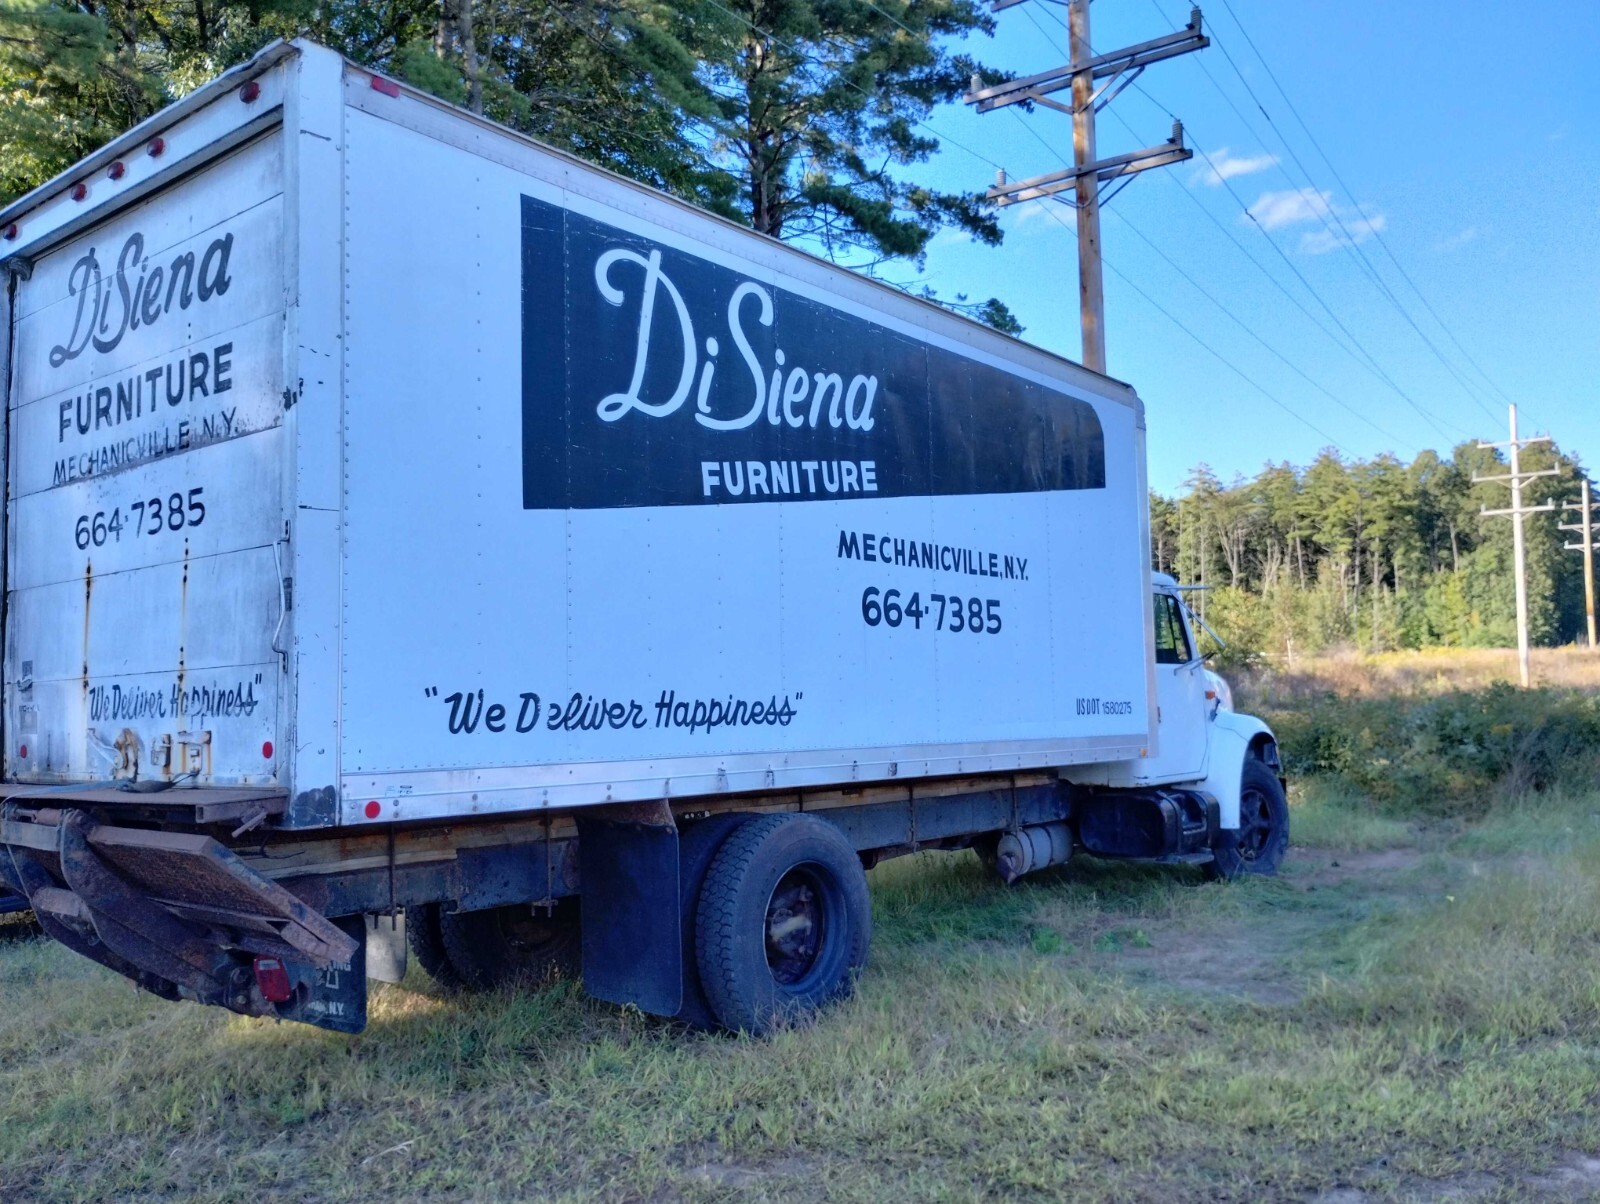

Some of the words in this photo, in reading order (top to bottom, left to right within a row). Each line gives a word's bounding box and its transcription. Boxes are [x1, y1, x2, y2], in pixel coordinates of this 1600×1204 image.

[50, 232, 234, 368] DiSiena
[594, 248, 878, 431] DiSiena
[59, 342, 233, 442] FURNITURE
[701, 460, 878, 496] FURNITURE
[112, 684, 167, 721] Deliver
[515, 692, 647, 733] Deliver
